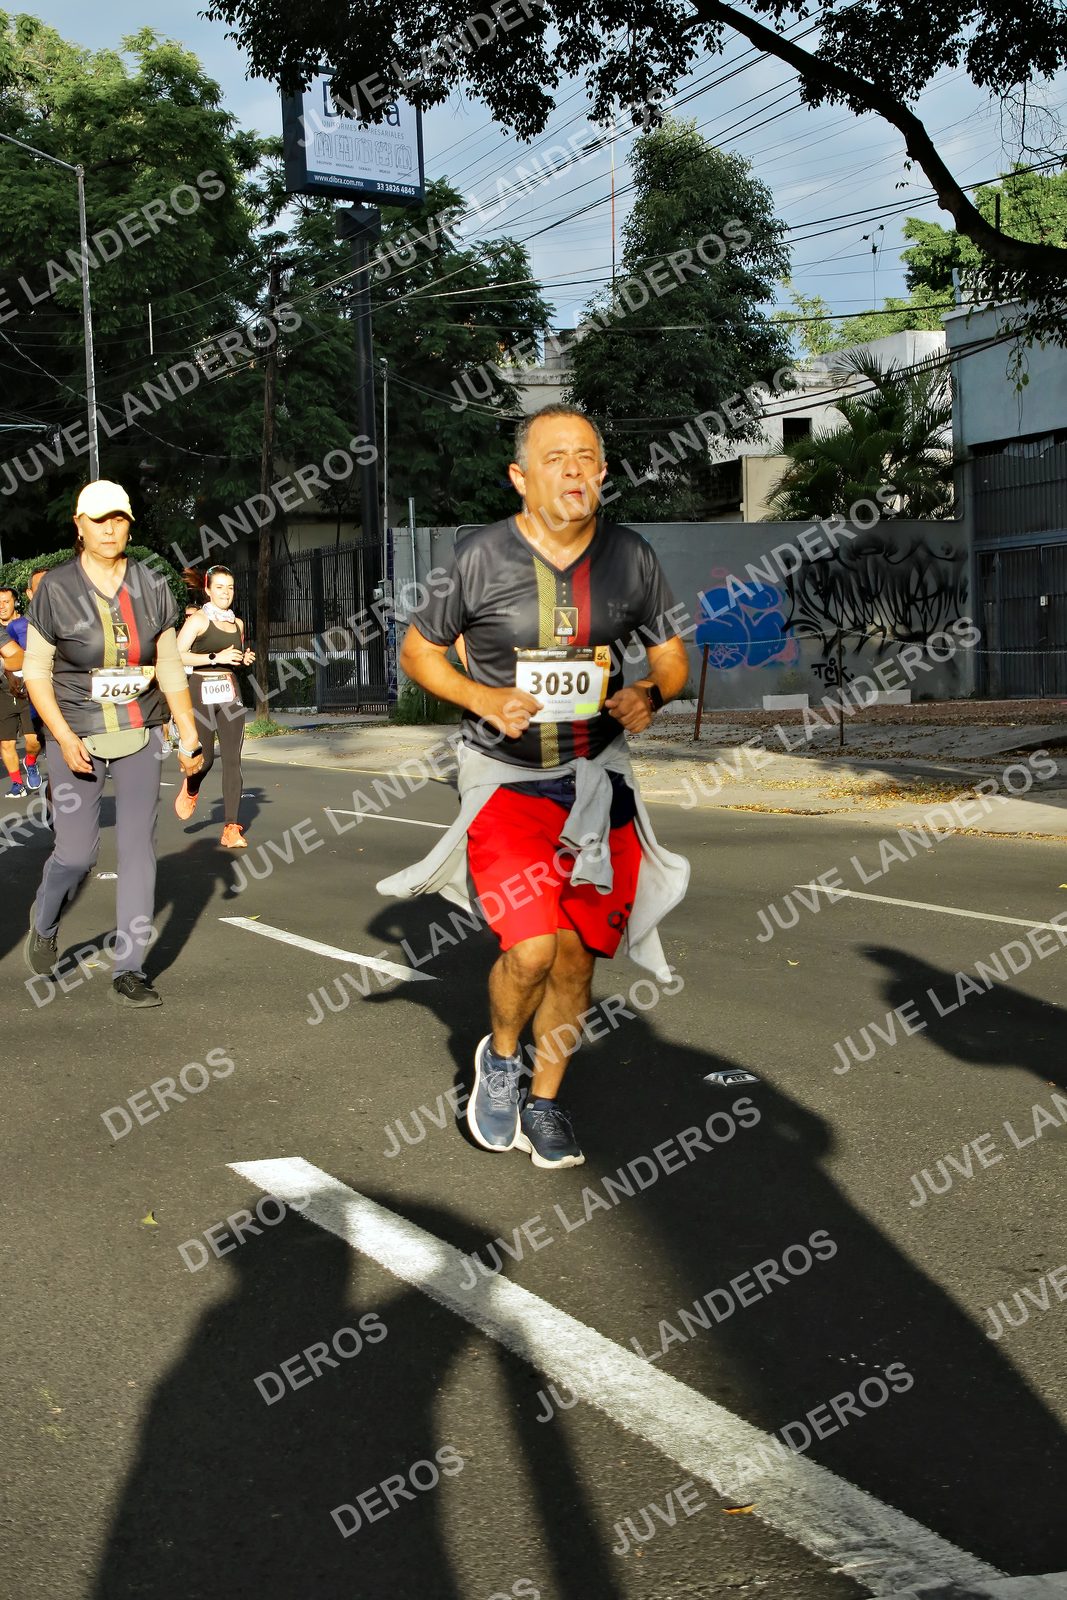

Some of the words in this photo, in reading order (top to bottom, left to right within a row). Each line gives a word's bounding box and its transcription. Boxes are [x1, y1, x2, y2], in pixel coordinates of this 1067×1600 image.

[358, 125, 405, 140] MPRESARIALES
[313, 174, 364, 187] www.dibra.com.mx
[376, 182, 385, 191] 33
[385, 184, 400, 192] 3826
[400, 185, 415, 195] 4845
[100, 683, 141, 698] 2645
[204, 683, 231, 695] 10608
[529, 671, 591, 696] 3030
